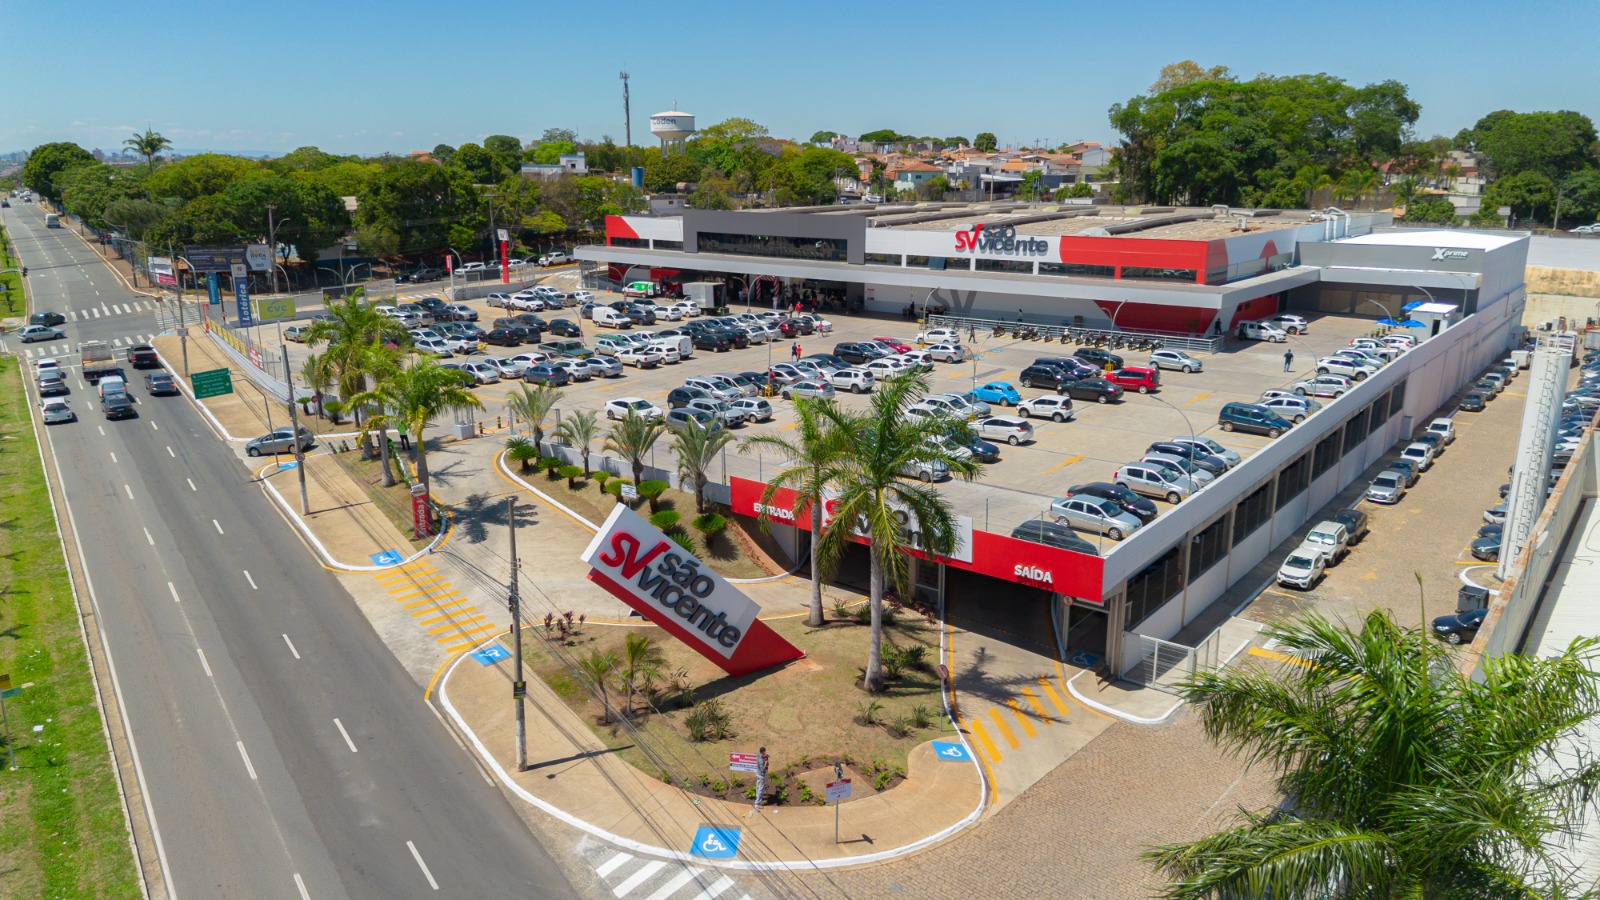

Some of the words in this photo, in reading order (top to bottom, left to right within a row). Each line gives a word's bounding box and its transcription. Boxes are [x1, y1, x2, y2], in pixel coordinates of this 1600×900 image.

[978, 237, 1048, 253] vicente
[239, 283, 251, 321] Lotérica
[598, 531, 672, 580] SV
[657, 552, 715, 599] são
[1013, 564, 1053, 584] SAÍDA
[637, 565, 742, 648] vicente
